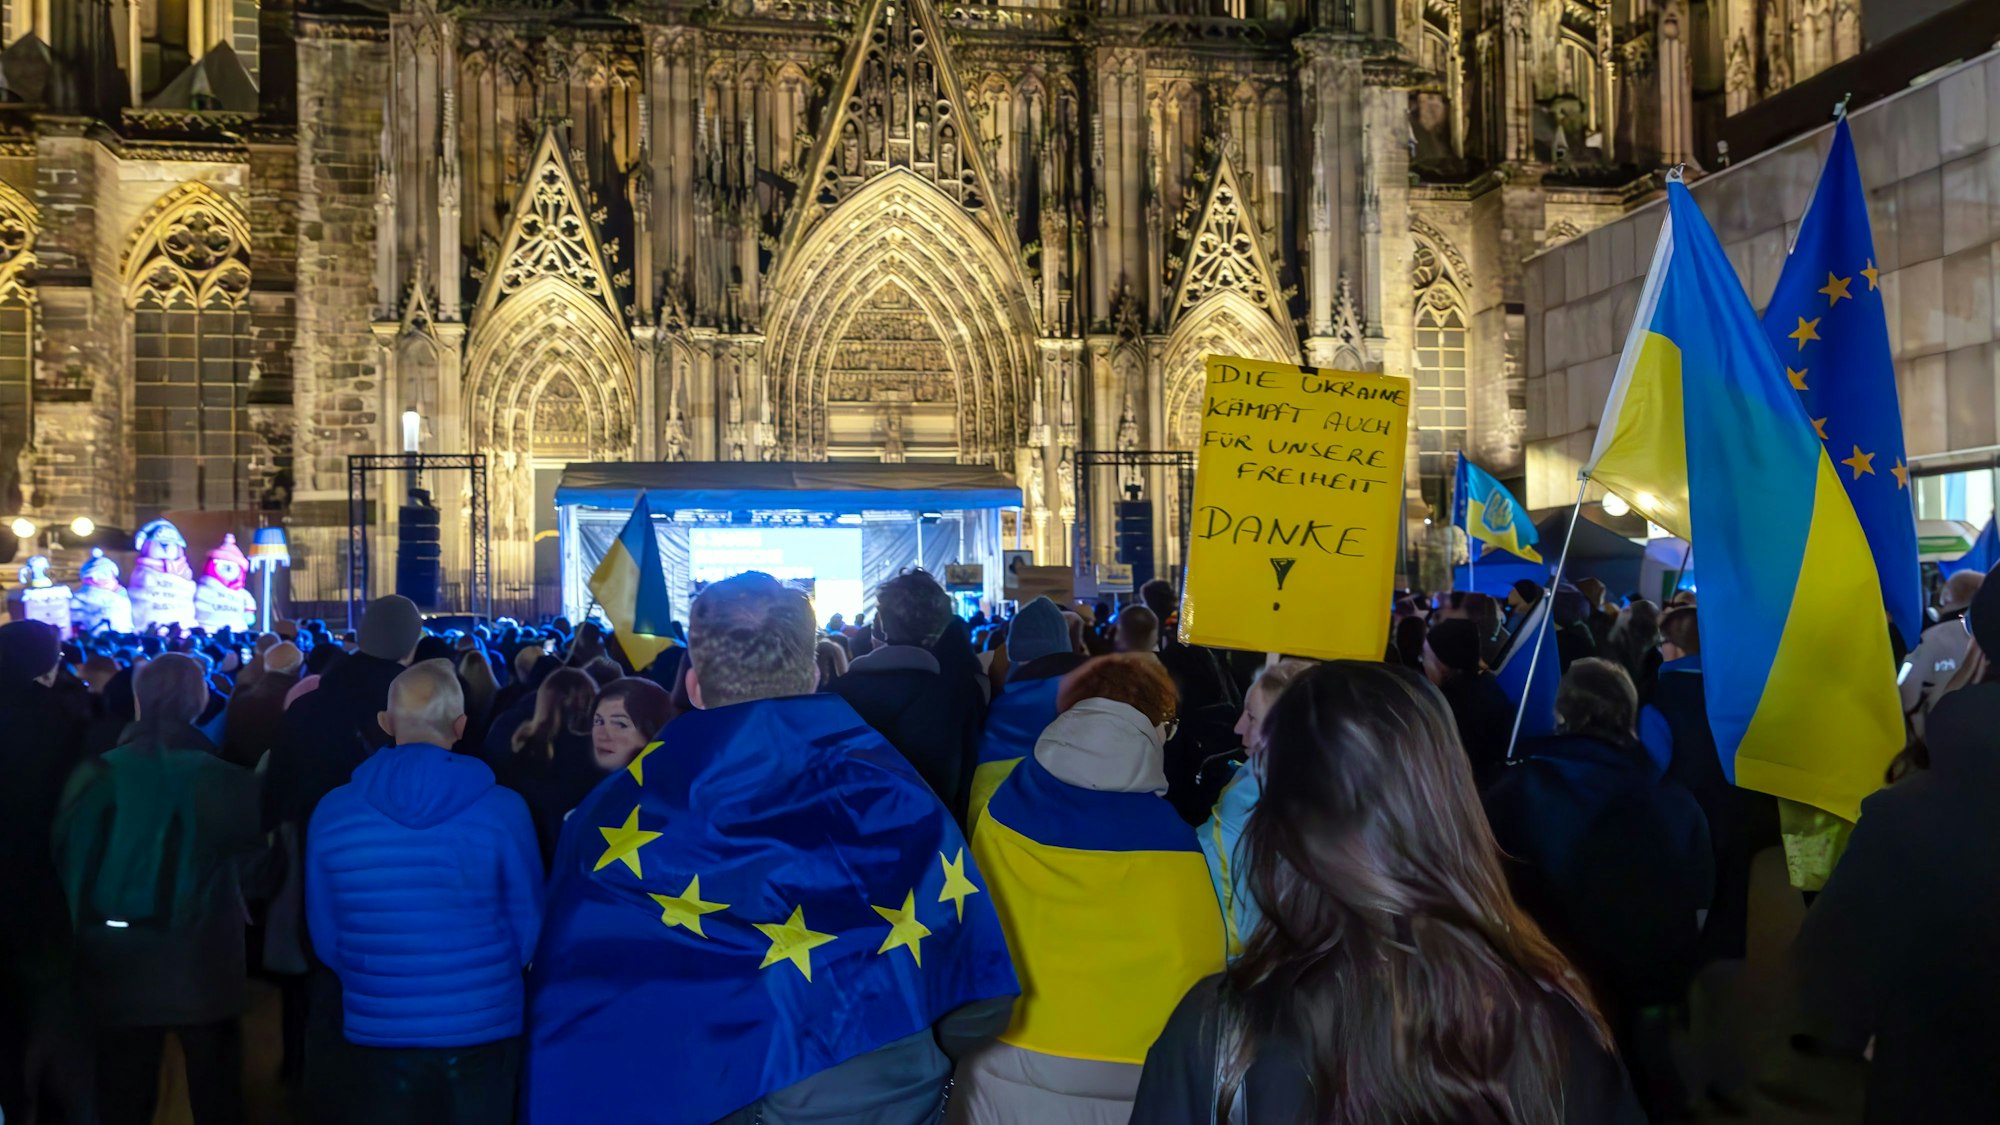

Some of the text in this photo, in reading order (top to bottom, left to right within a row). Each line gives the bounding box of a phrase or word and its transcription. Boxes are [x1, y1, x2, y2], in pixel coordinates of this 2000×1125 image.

[1211, 364, 1408, 407] DIE UKRAINE
[1323, 411, 1391, 435] AUCH
[1203, 430, 1387, 468] FÜR UNSERE
[1237, 462, 1387, 493] FREIHEIT
[1198, 505, 1367, 557] DANKE
